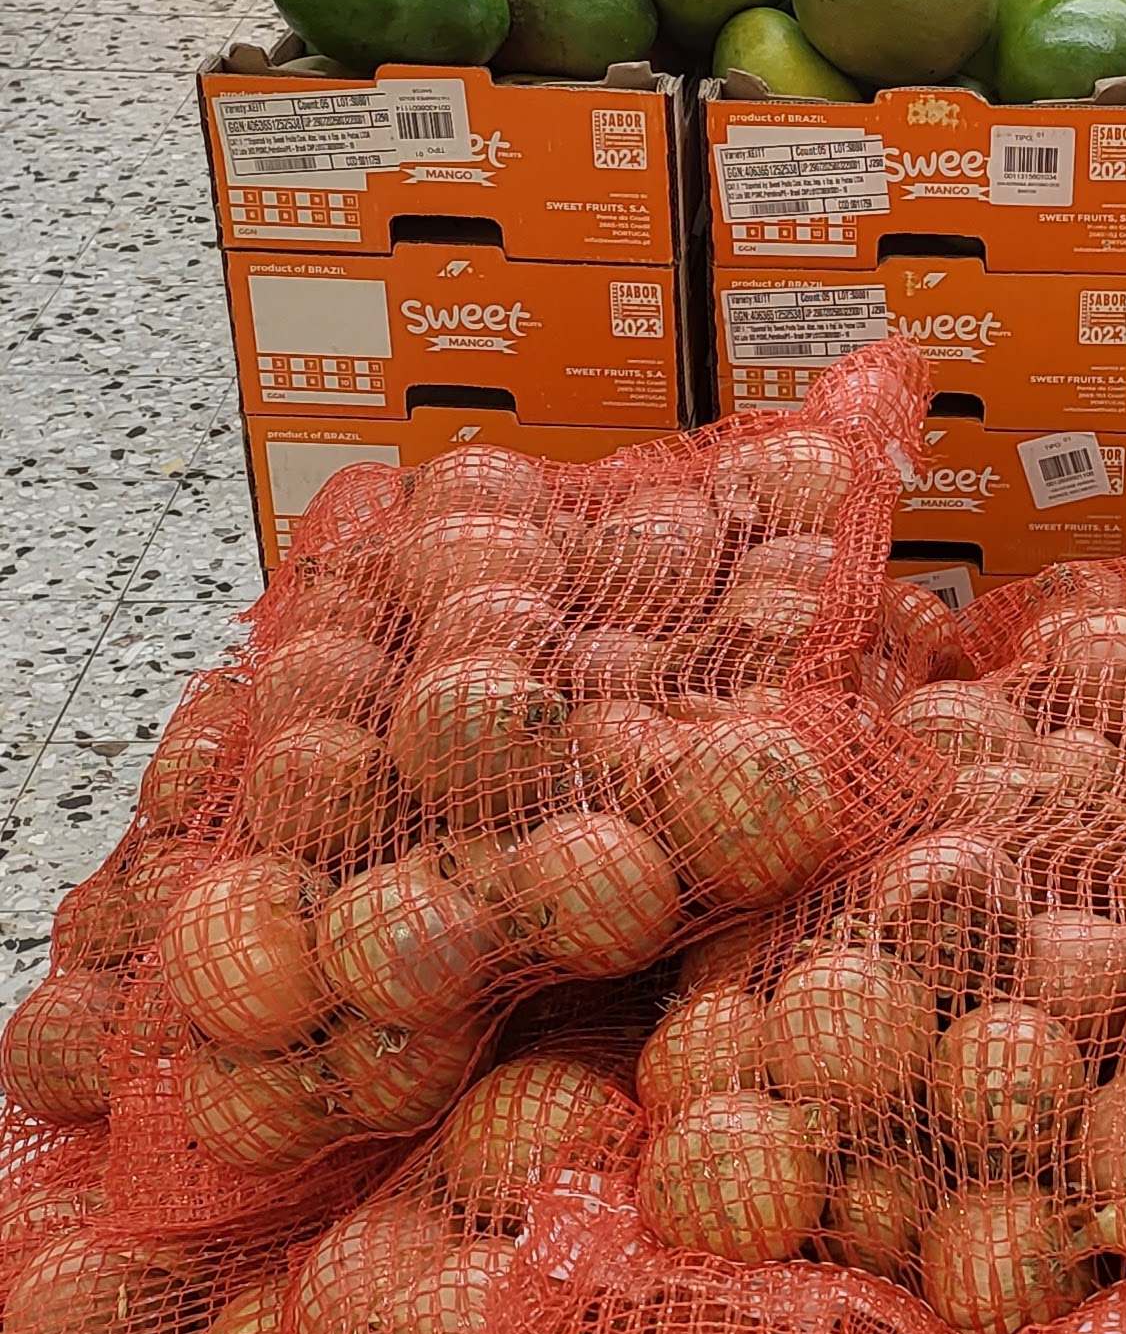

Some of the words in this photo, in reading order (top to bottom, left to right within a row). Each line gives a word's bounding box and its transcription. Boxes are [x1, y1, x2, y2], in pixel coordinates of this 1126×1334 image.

[602, 113, 641, 128] SABOR
[729, 114, 771, 125] product
[774, 114, 785, 123] of
[788, 114, 827, 123] BRAZIL
[595, 149, 645, 168] 2023
[882, 147, 990, 182] Swee
[425, 170, 473, 180] MANGO
[924, 185, 970, 195] MANGO
[546, 201, 583, 211] SWEET
[629, 204, 650, 213] S.A.
[1039, 213, 1074, 223] SWEET
[250, 263, 291, 275] product
[294, 264, 306, 274] of
[308, 266, 347, 276] BRAZIL
[731, 280, 772, 290] product
[774, 280, 786, 288] of
[618, 284, 659, 300] SABOR
[1088, 293, 1126, 307] SABOR
[401, 299, 531, 335] Sweet
[613, 318, 662, 336] 2023
[448, 337, 495, 349] MANGO
[919, 348, 964, 358] MANGO
[565, 367, 601, 377] SWEET
[645, 369, 666, 378] S.A.
[1030, 374, 1064, 384] SWEET
[1108, 375, 1126, 385] S.A.
[267, 429, 308, 441] product
[310, 430, 321, 439] of
[323, 432, 362, 442] BRAZIL
[1100, 448, 1122, 462] BOR
[902, 466, 1001, 497] weet
[921, 499, 964, 508] MANGO
[1028, 523, 1063, 532] SWEET
